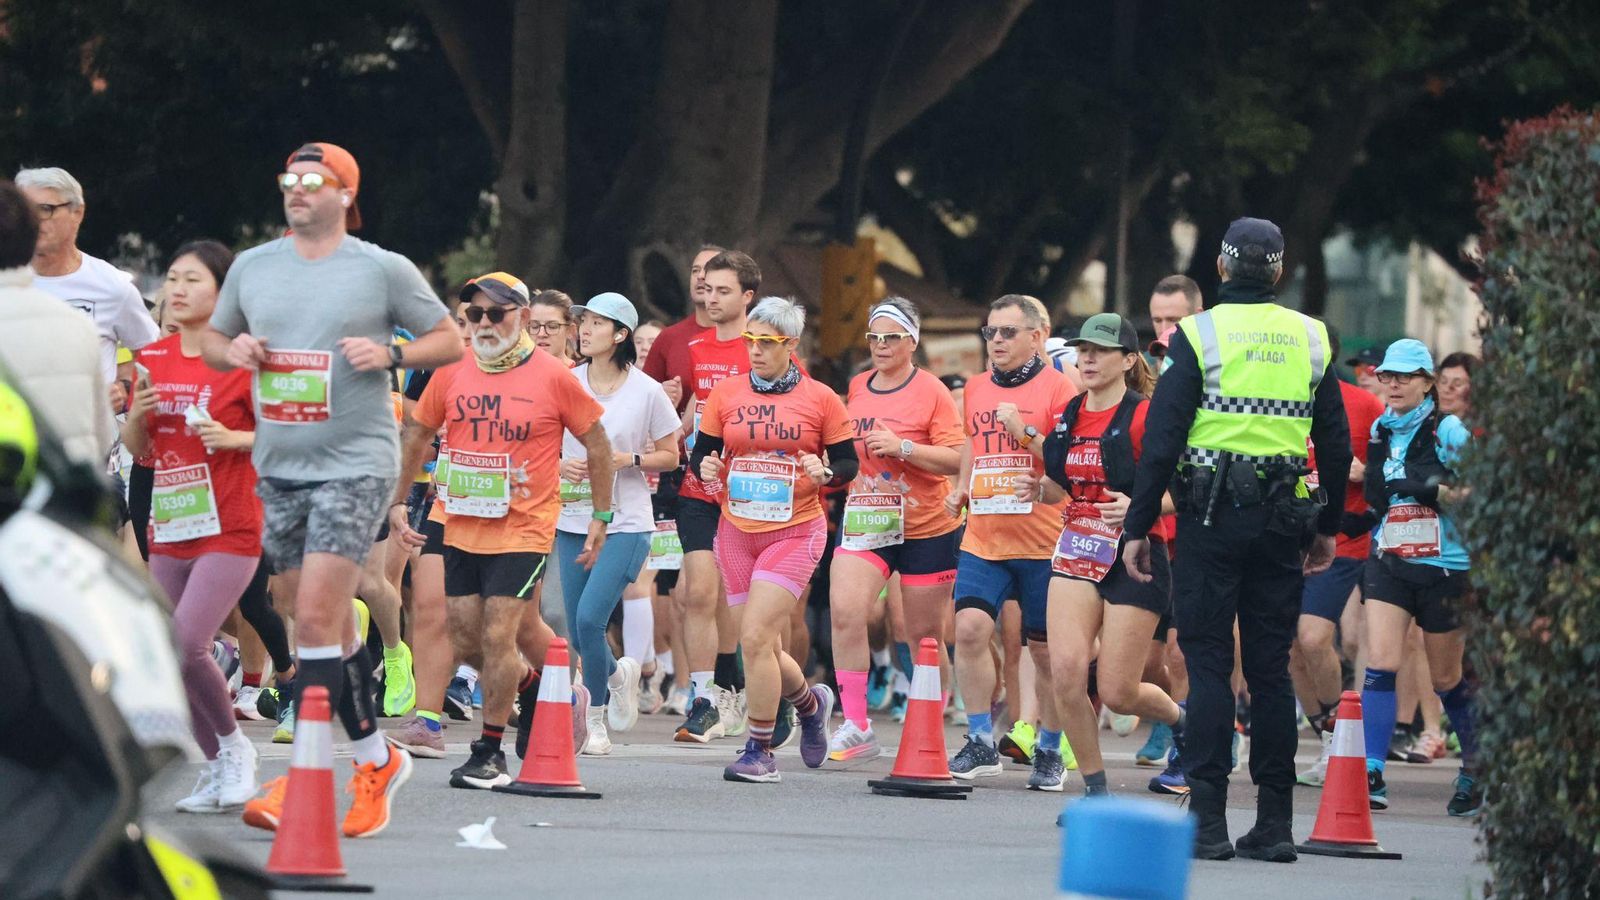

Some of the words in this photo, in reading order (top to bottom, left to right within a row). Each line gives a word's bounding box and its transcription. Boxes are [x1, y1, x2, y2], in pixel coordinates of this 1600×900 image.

[1271, 332, 1300, 347] LOCAL
[271, 376, 308, 392] 4036
[461, 455, 503, 467] GENERALI
[747, 461, 789, 474] GENERALI
[988, 457, 1027, 467] GENERALI
[458, 474, 493, 489] 11729
[741, 480, 778, 494] 11759
[159, 493, 196, 511] 15309
[856, 514, 890, 525] 11900
[1393, 524, 1421, 536] 3607
[1071, 535, 1102, 553] 5467
